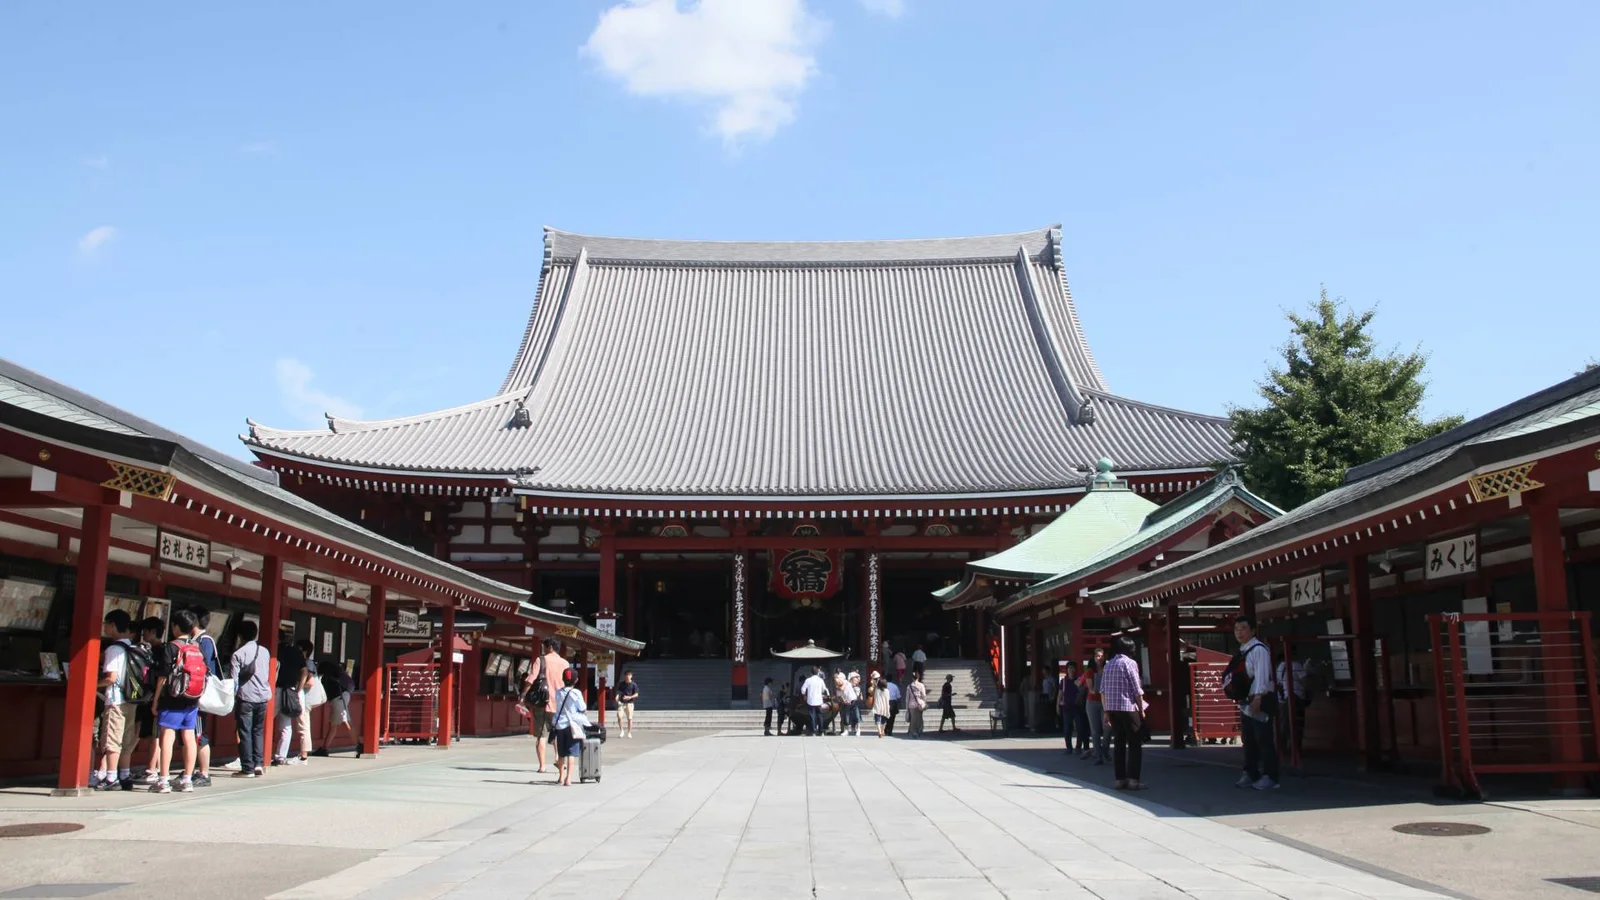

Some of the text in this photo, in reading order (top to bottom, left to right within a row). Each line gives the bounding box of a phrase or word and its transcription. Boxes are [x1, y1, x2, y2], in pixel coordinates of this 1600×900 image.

[162, 536, 204, 565] お札お守
[1431, 540, 1474, 572] みくじ
[307, 583, 332, 602] お札お守
[1294, 577, 1320, 601] みくじ
